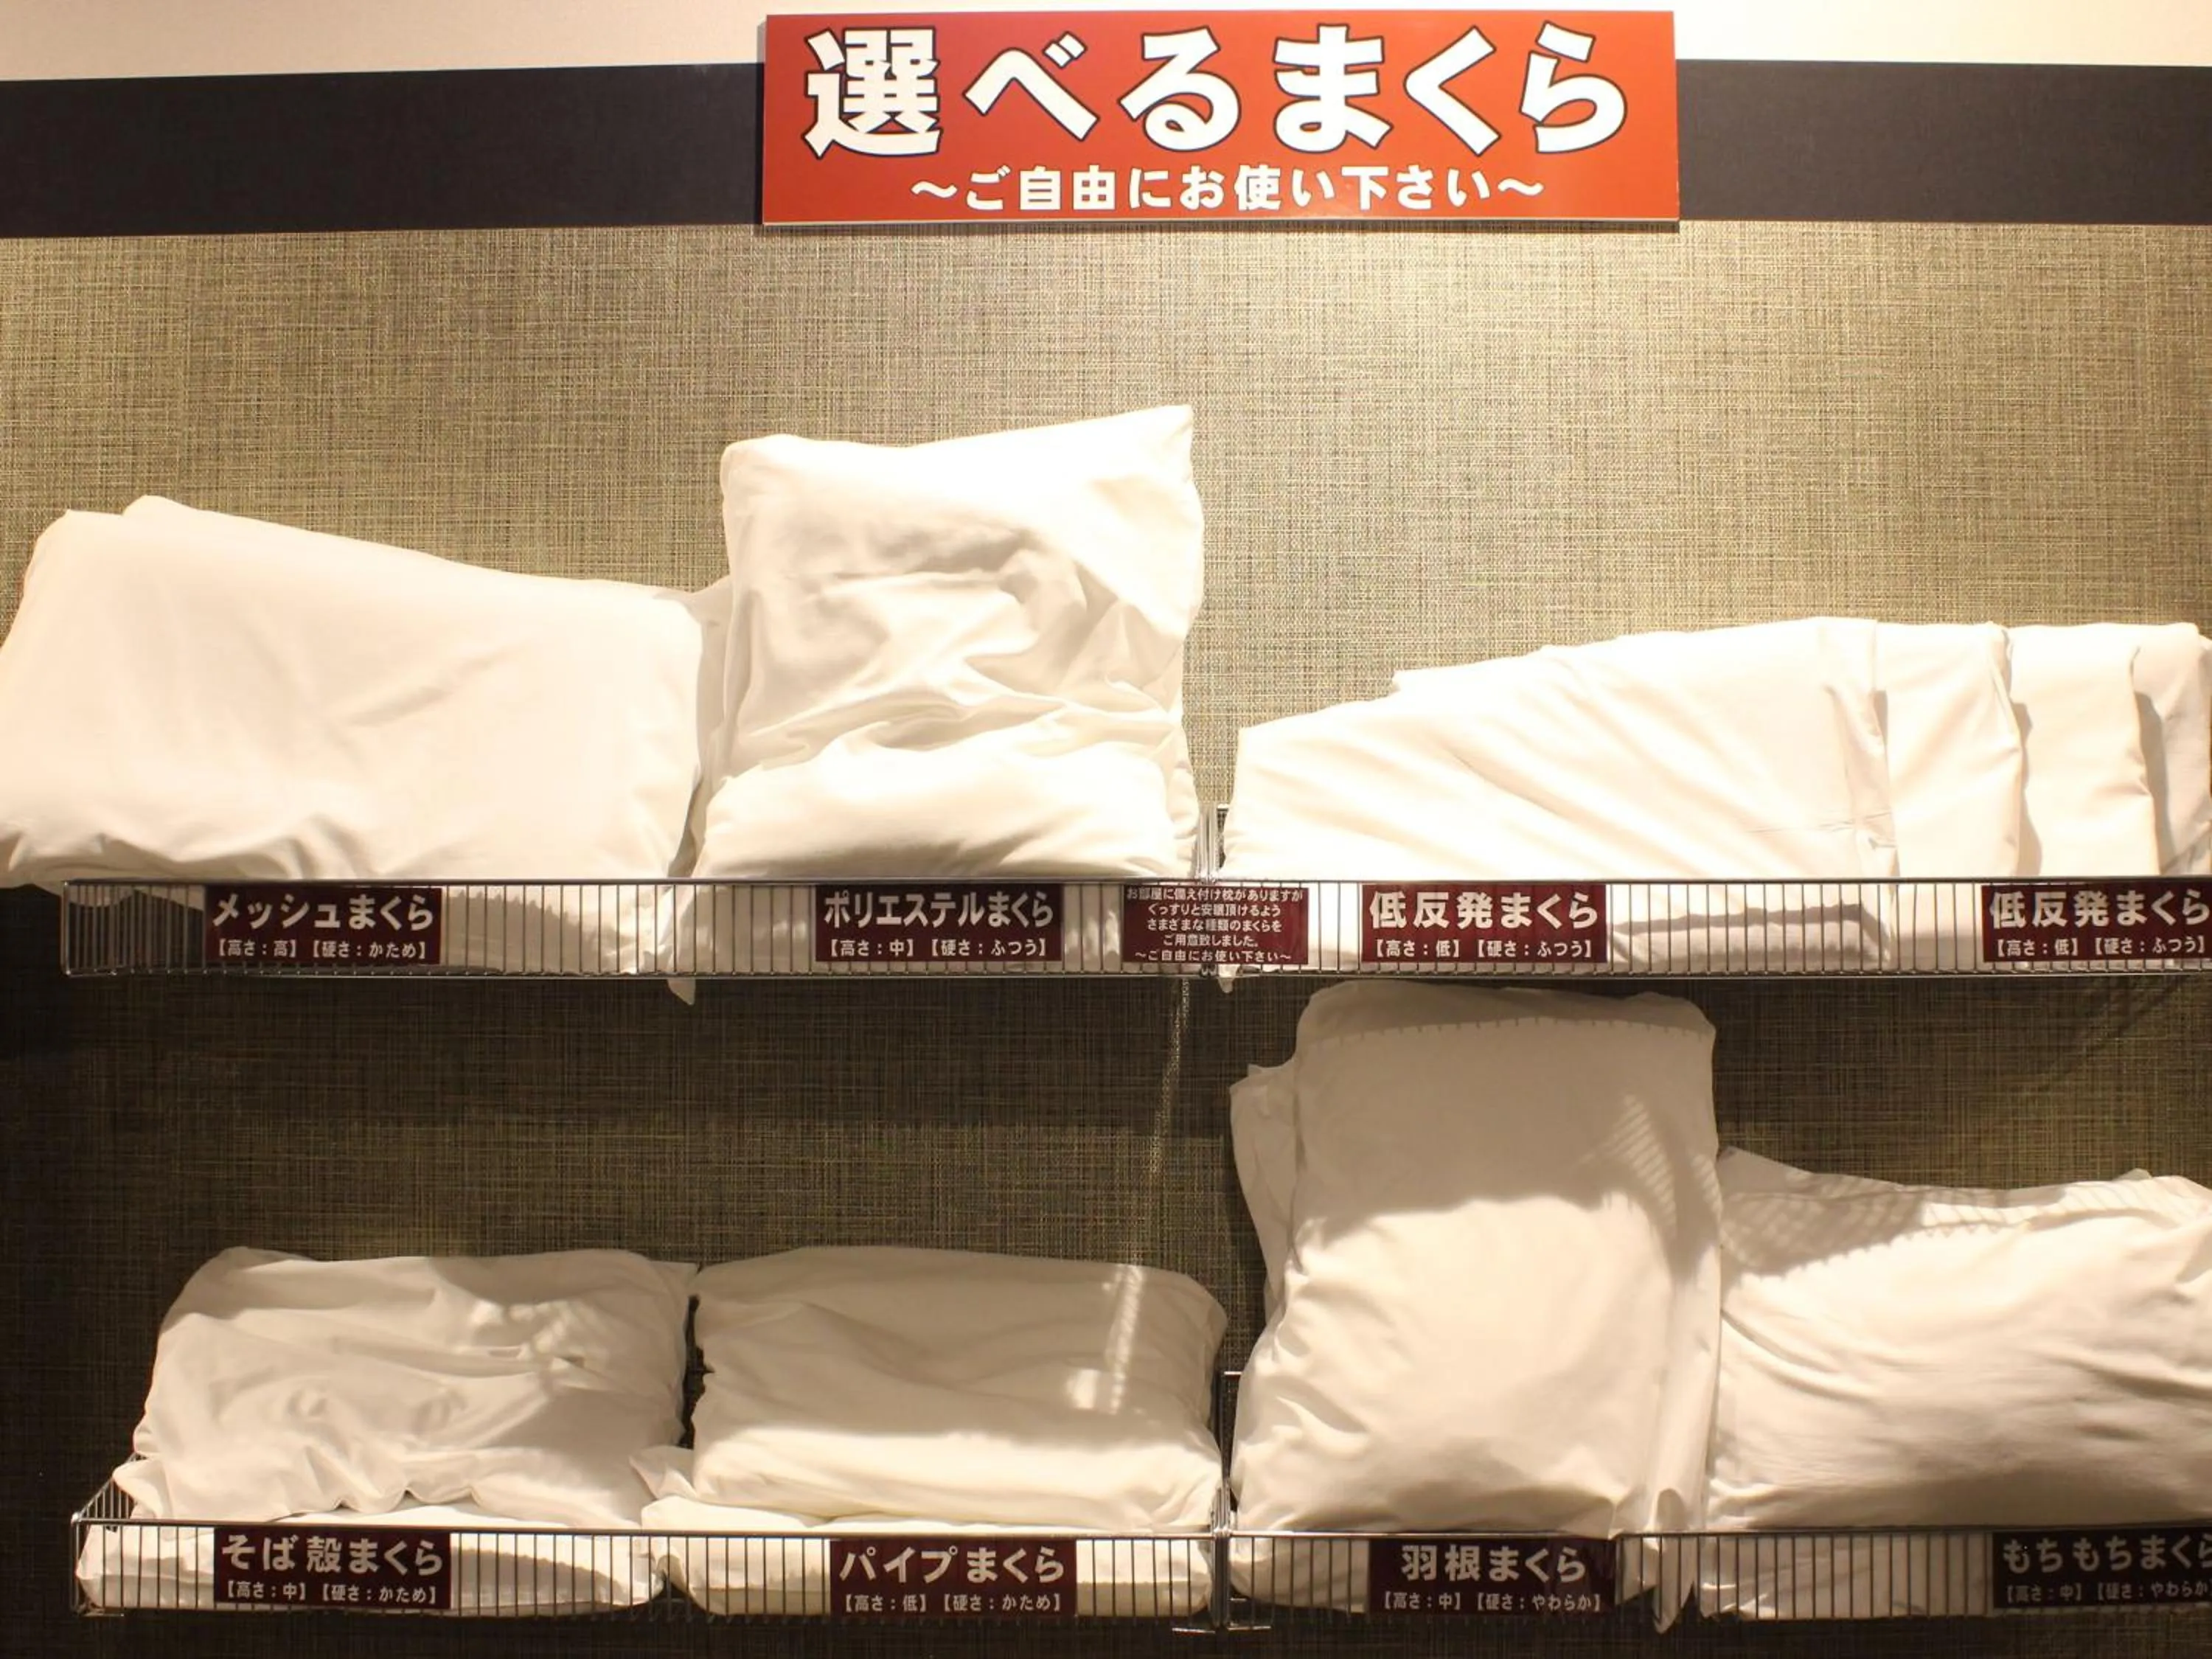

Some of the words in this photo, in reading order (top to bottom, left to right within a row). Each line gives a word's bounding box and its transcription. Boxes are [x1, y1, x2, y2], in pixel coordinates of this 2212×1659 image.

[801, 22, 1627, 159] 選べるまくら
[212, 894, 434, 931] メッシュまくら
[824, 890, 1054, 928] ポリエステルまくら
[1369, 891, 1598, 929] 低反発まくら
[1989, 888, 2210, 929] 低反発まくら
[222, 1534, 442, 1576] そば殻まくら
[839, 1545, 1064, 1584] パイプまくら
[1401, 1544, 1585, 1582] 羽根まくら
